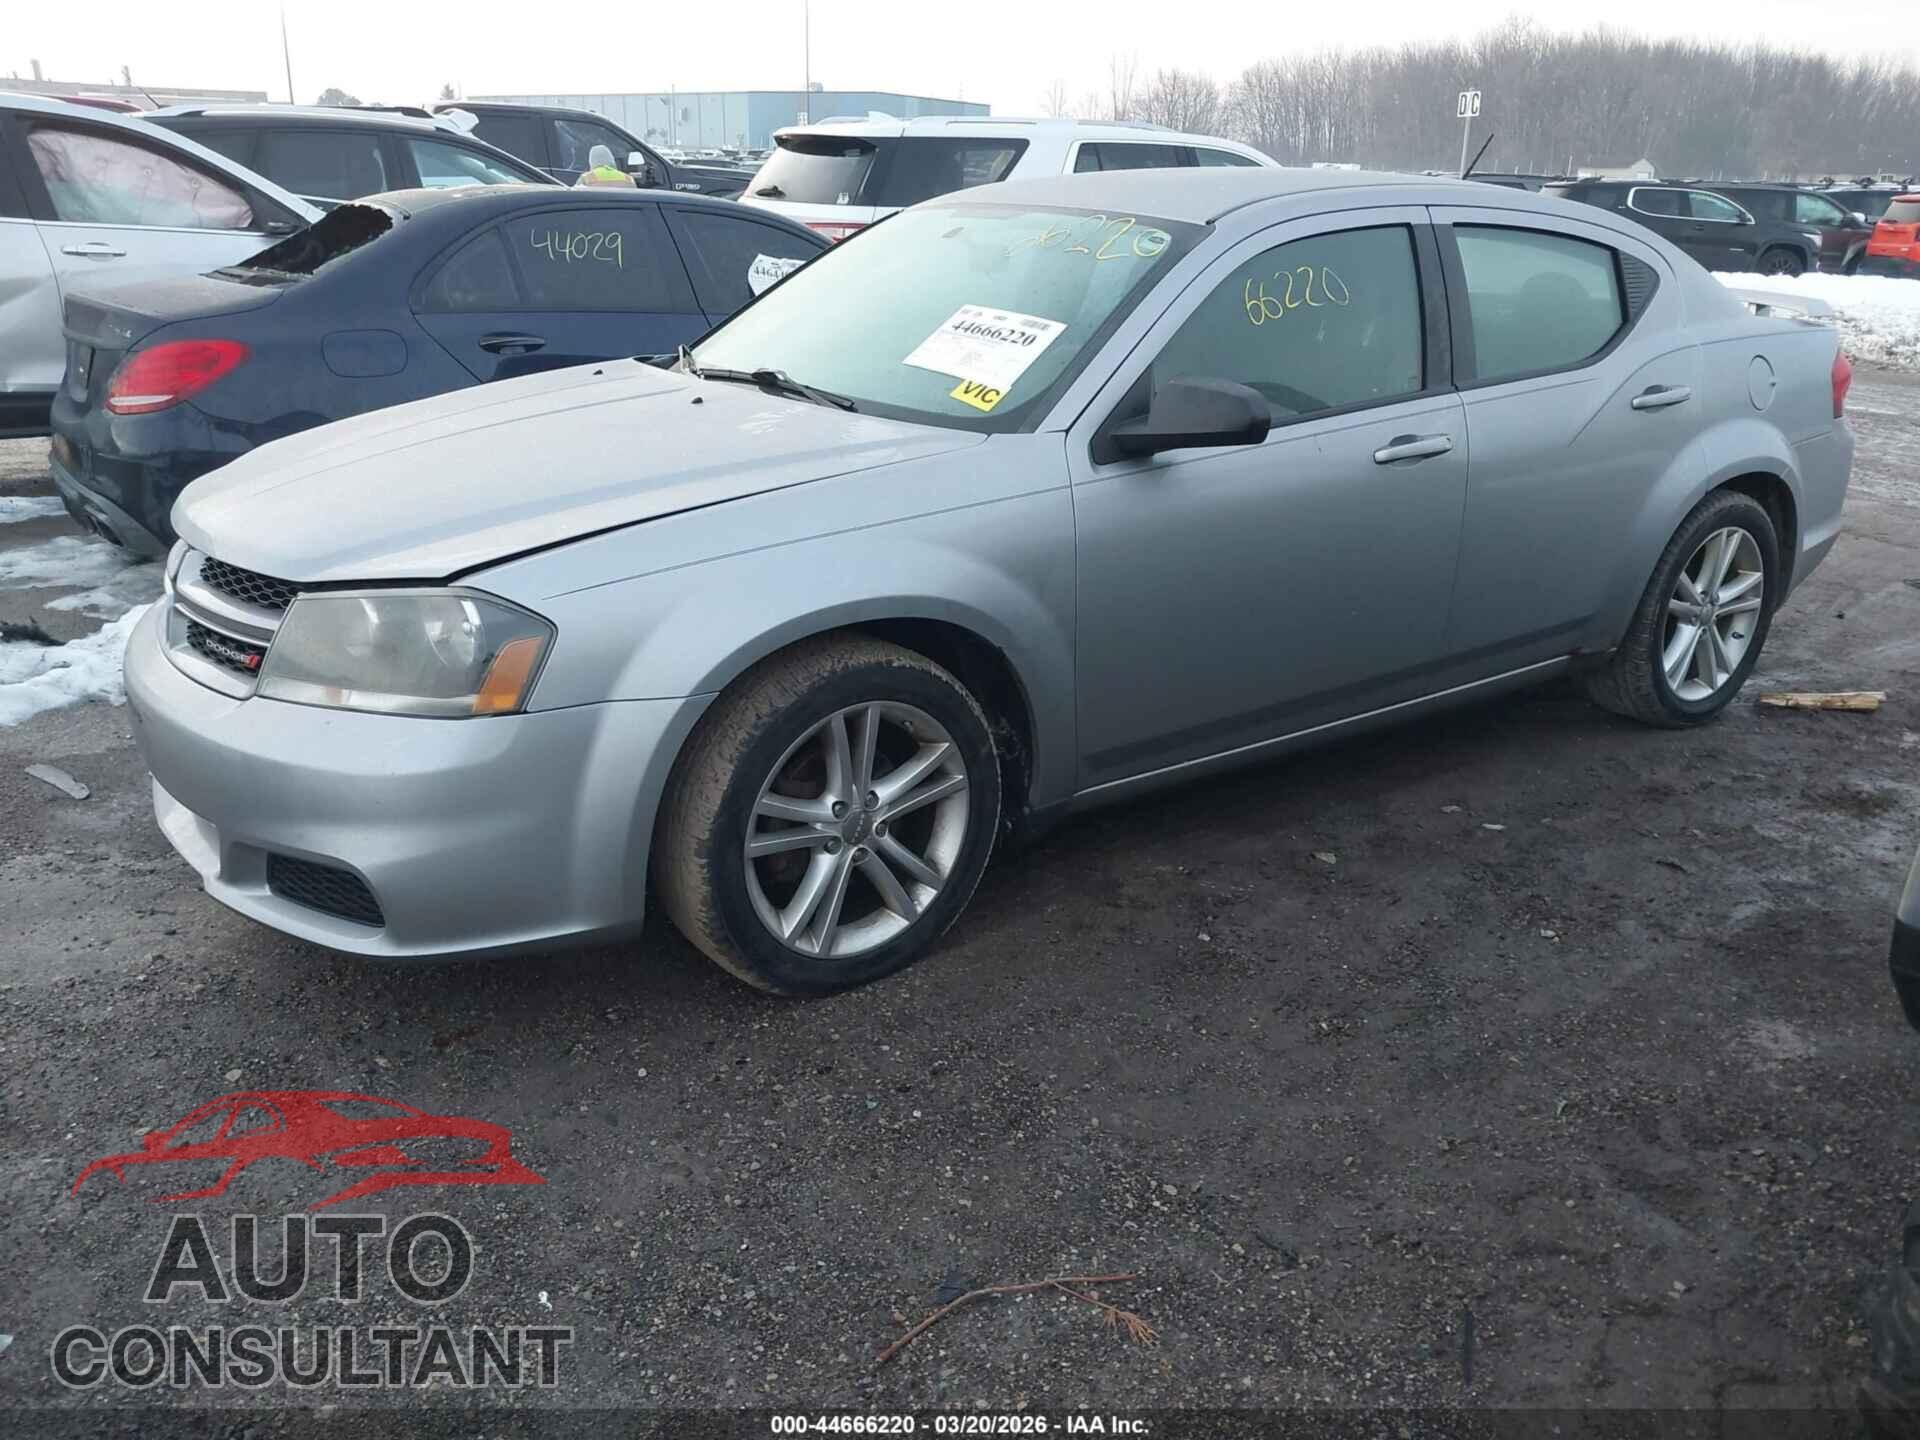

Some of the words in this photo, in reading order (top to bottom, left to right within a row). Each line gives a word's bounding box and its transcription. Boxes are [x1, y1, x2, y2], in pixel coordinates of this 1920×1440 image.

[531, 229, 623, 269] 44029
[1245, 265, 1349, 325] 66220
[951, 319, 1038, 347] 44666220
[962, 380, 1001, 404] VIC
[206, 639, 247, 663] DODGE
